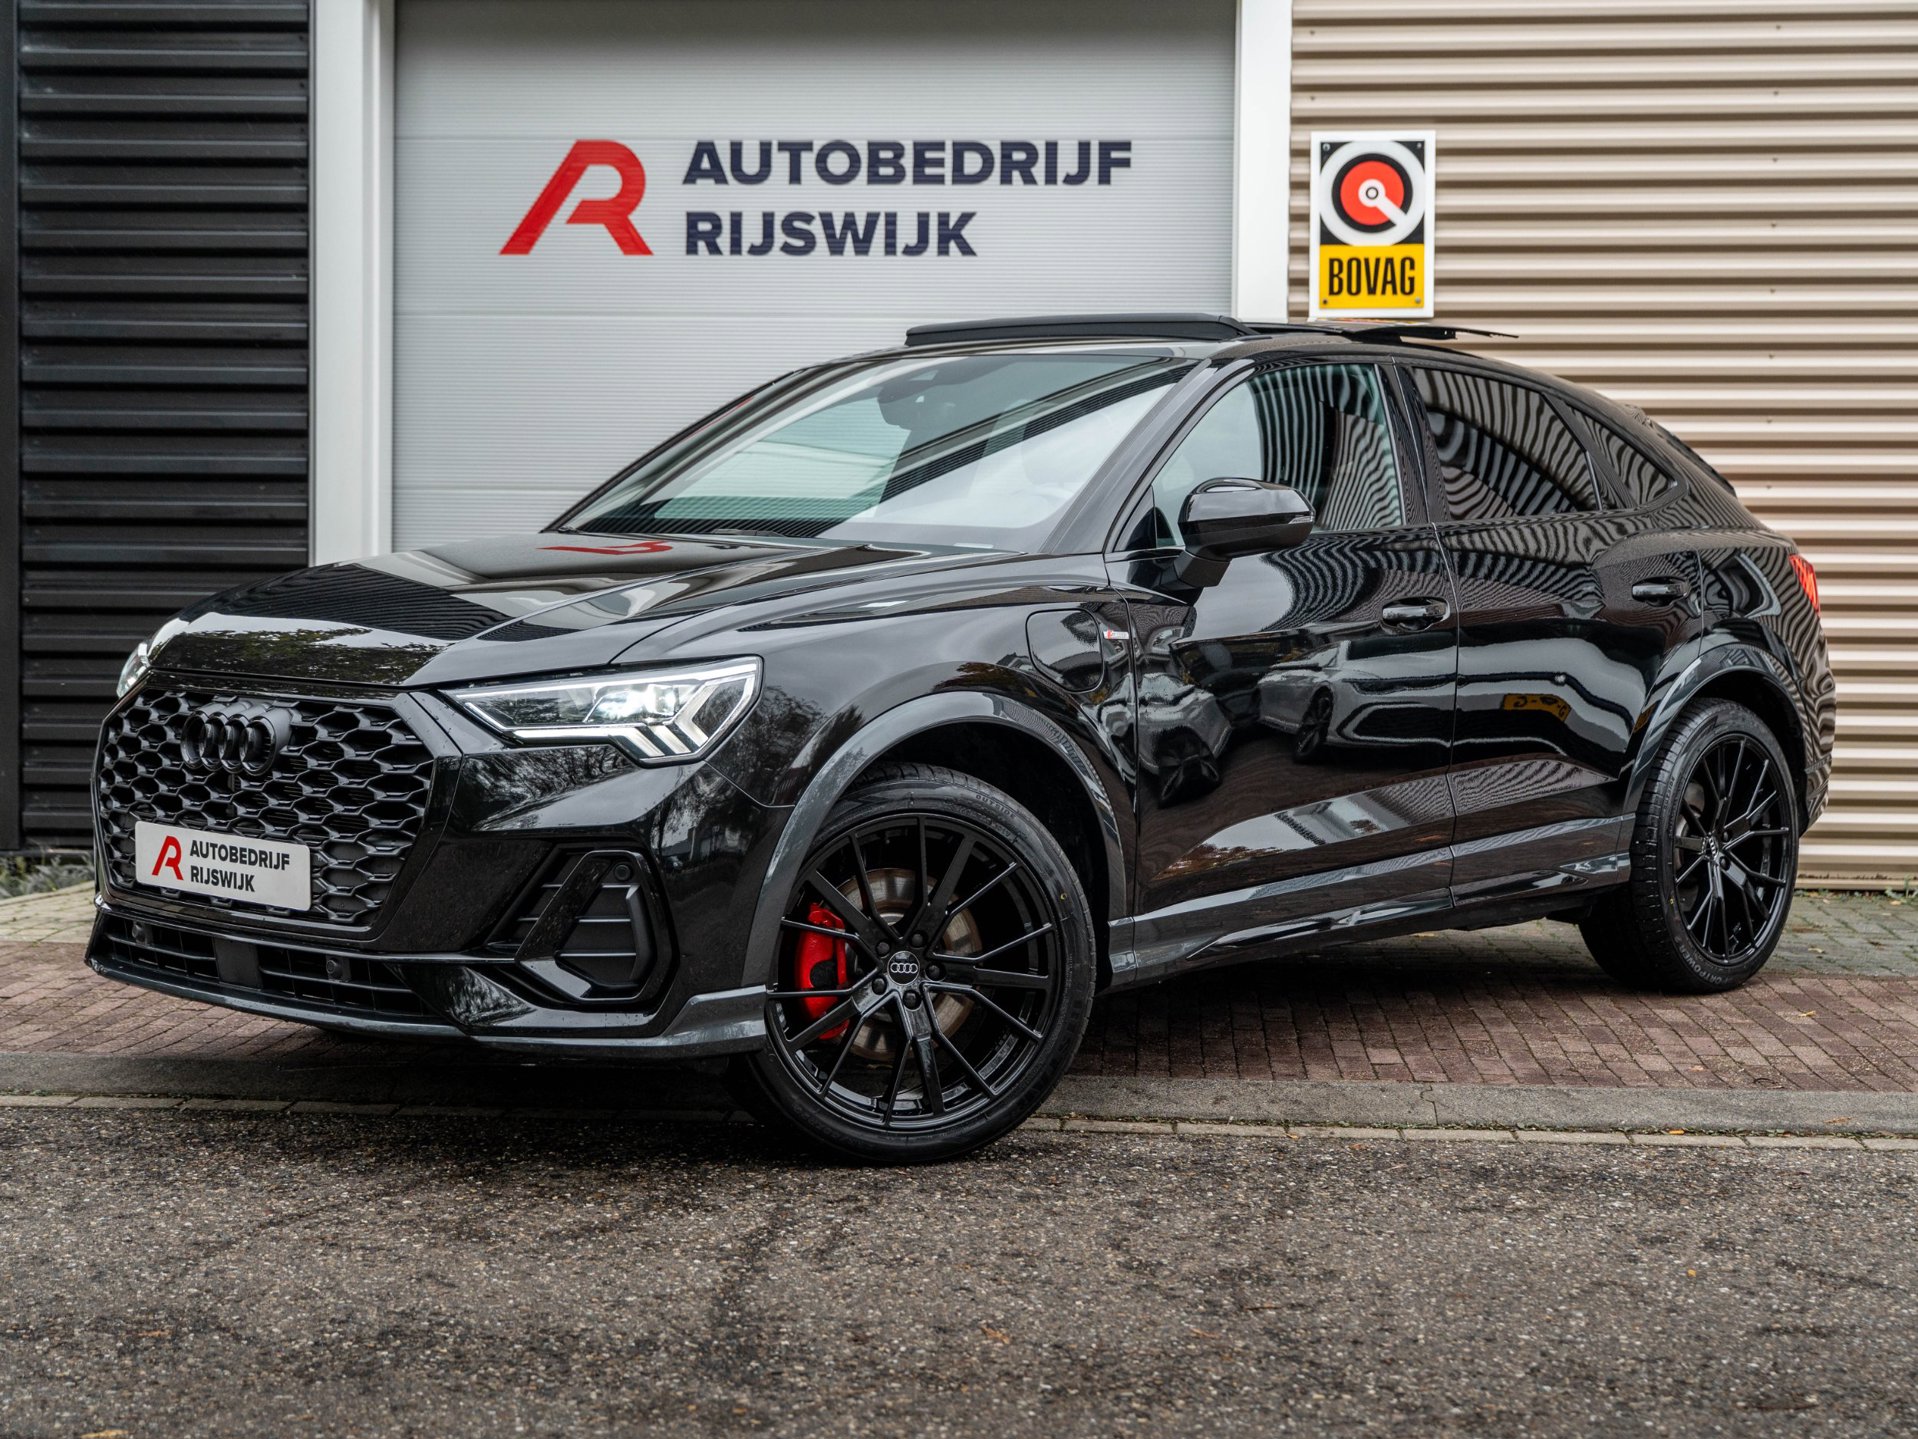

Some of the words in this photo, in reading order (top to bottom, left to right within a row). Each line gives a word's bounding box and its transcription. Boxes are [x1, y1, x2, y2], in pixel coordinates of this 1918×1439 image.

[683, 139, 1132, 186] AUTOBEDRIJF
[685, 211, 977, 257] RIJSWIJK
[1328, 256, 1416, 297] BOVAG
[975, 794, 1018, 819] OUTSIDE
[189, 839, 291, 871] AUTOBEDRIJF
[190, 864, 256, 893] RIJSWIJK
